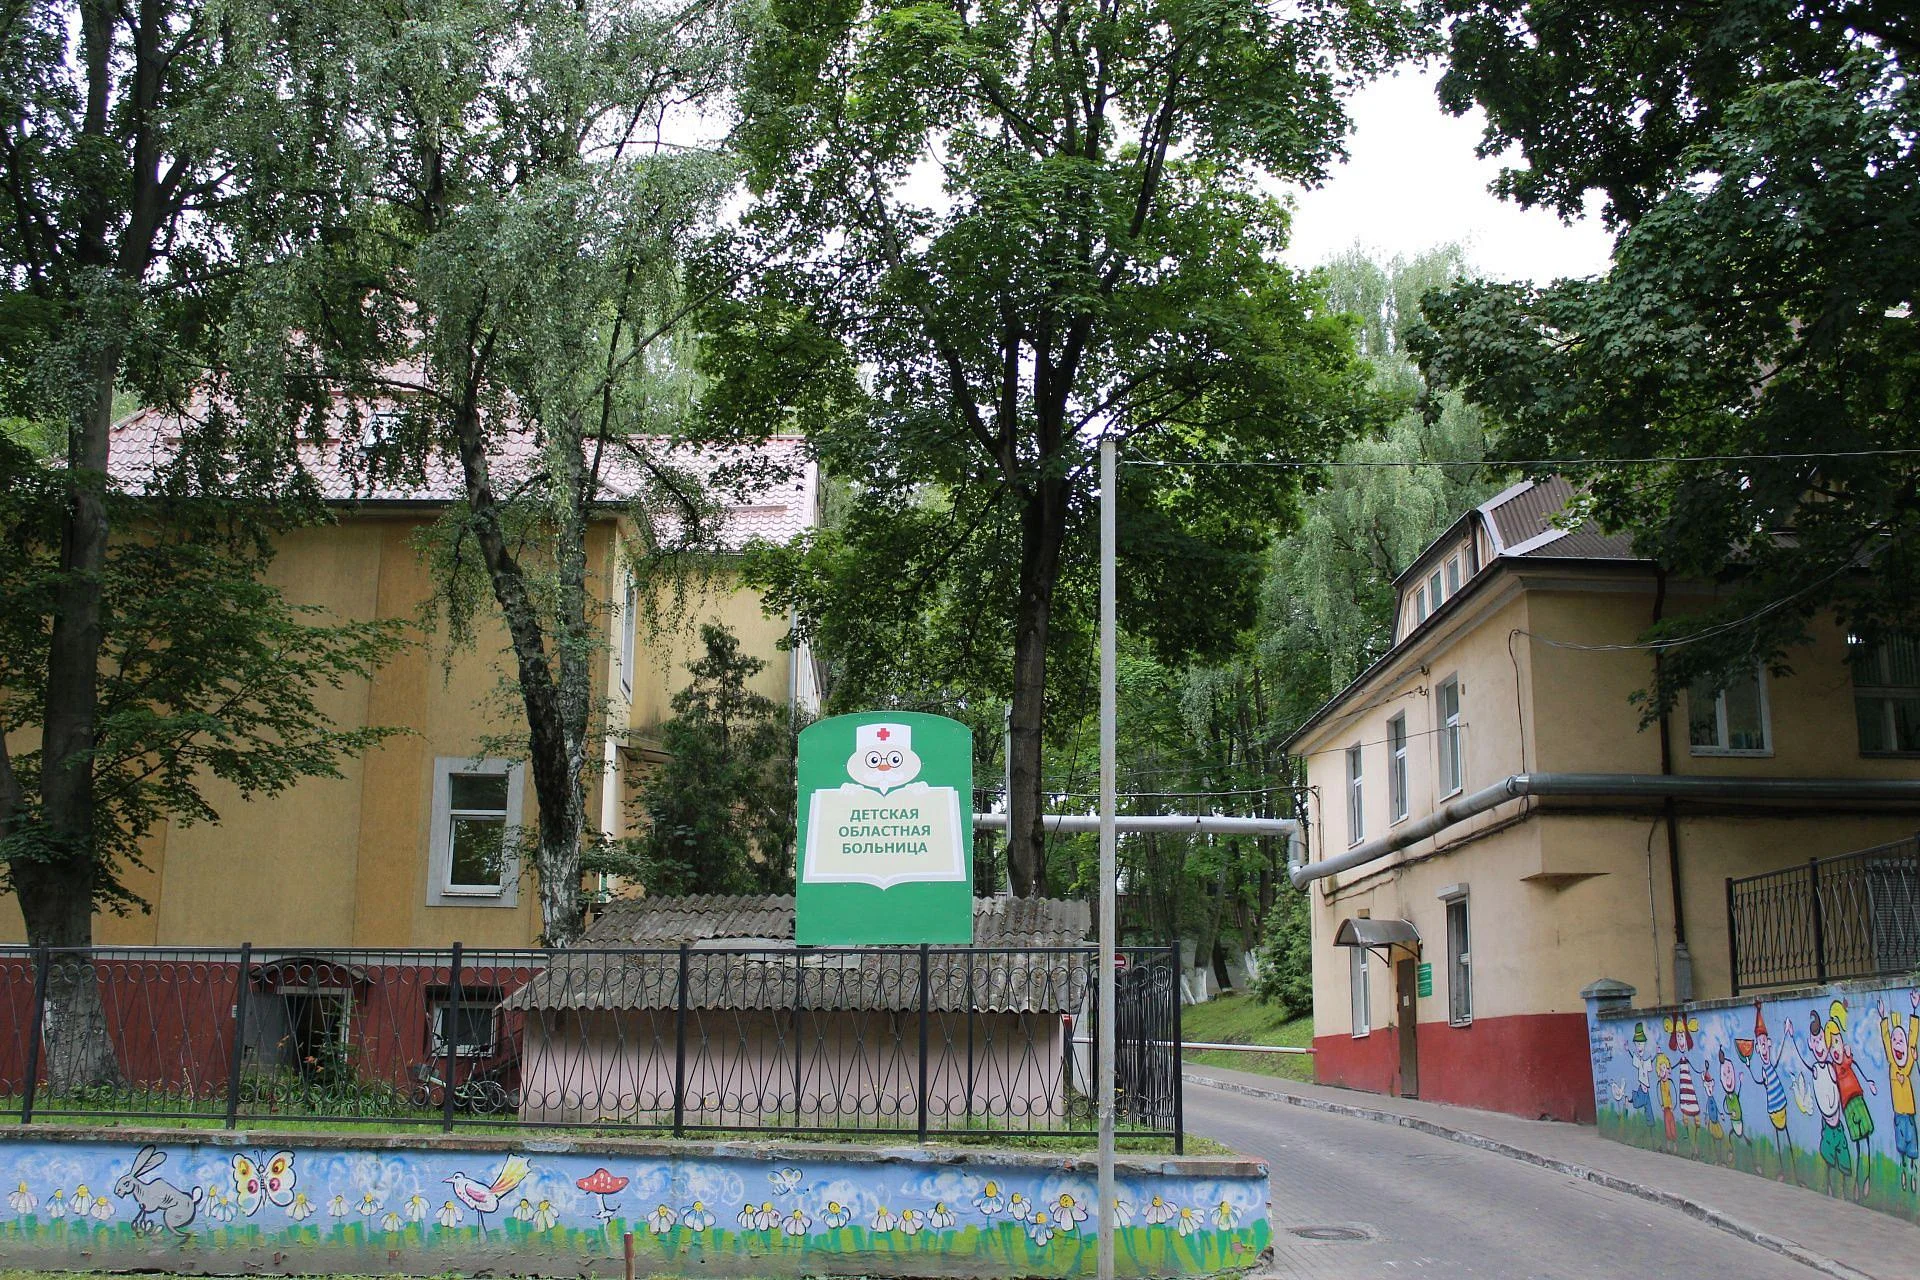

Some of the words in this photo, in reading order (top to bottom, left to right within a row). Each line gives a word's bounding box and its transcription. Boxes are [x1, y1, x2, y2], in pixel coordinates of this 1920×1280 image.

[849, 808, 919, 822] ДЕТСКАЯ
[838, 825, 931, 837] ОБЛАСТНАЯ
[842, 842, 928, 855] БОЛЬНИЦА
